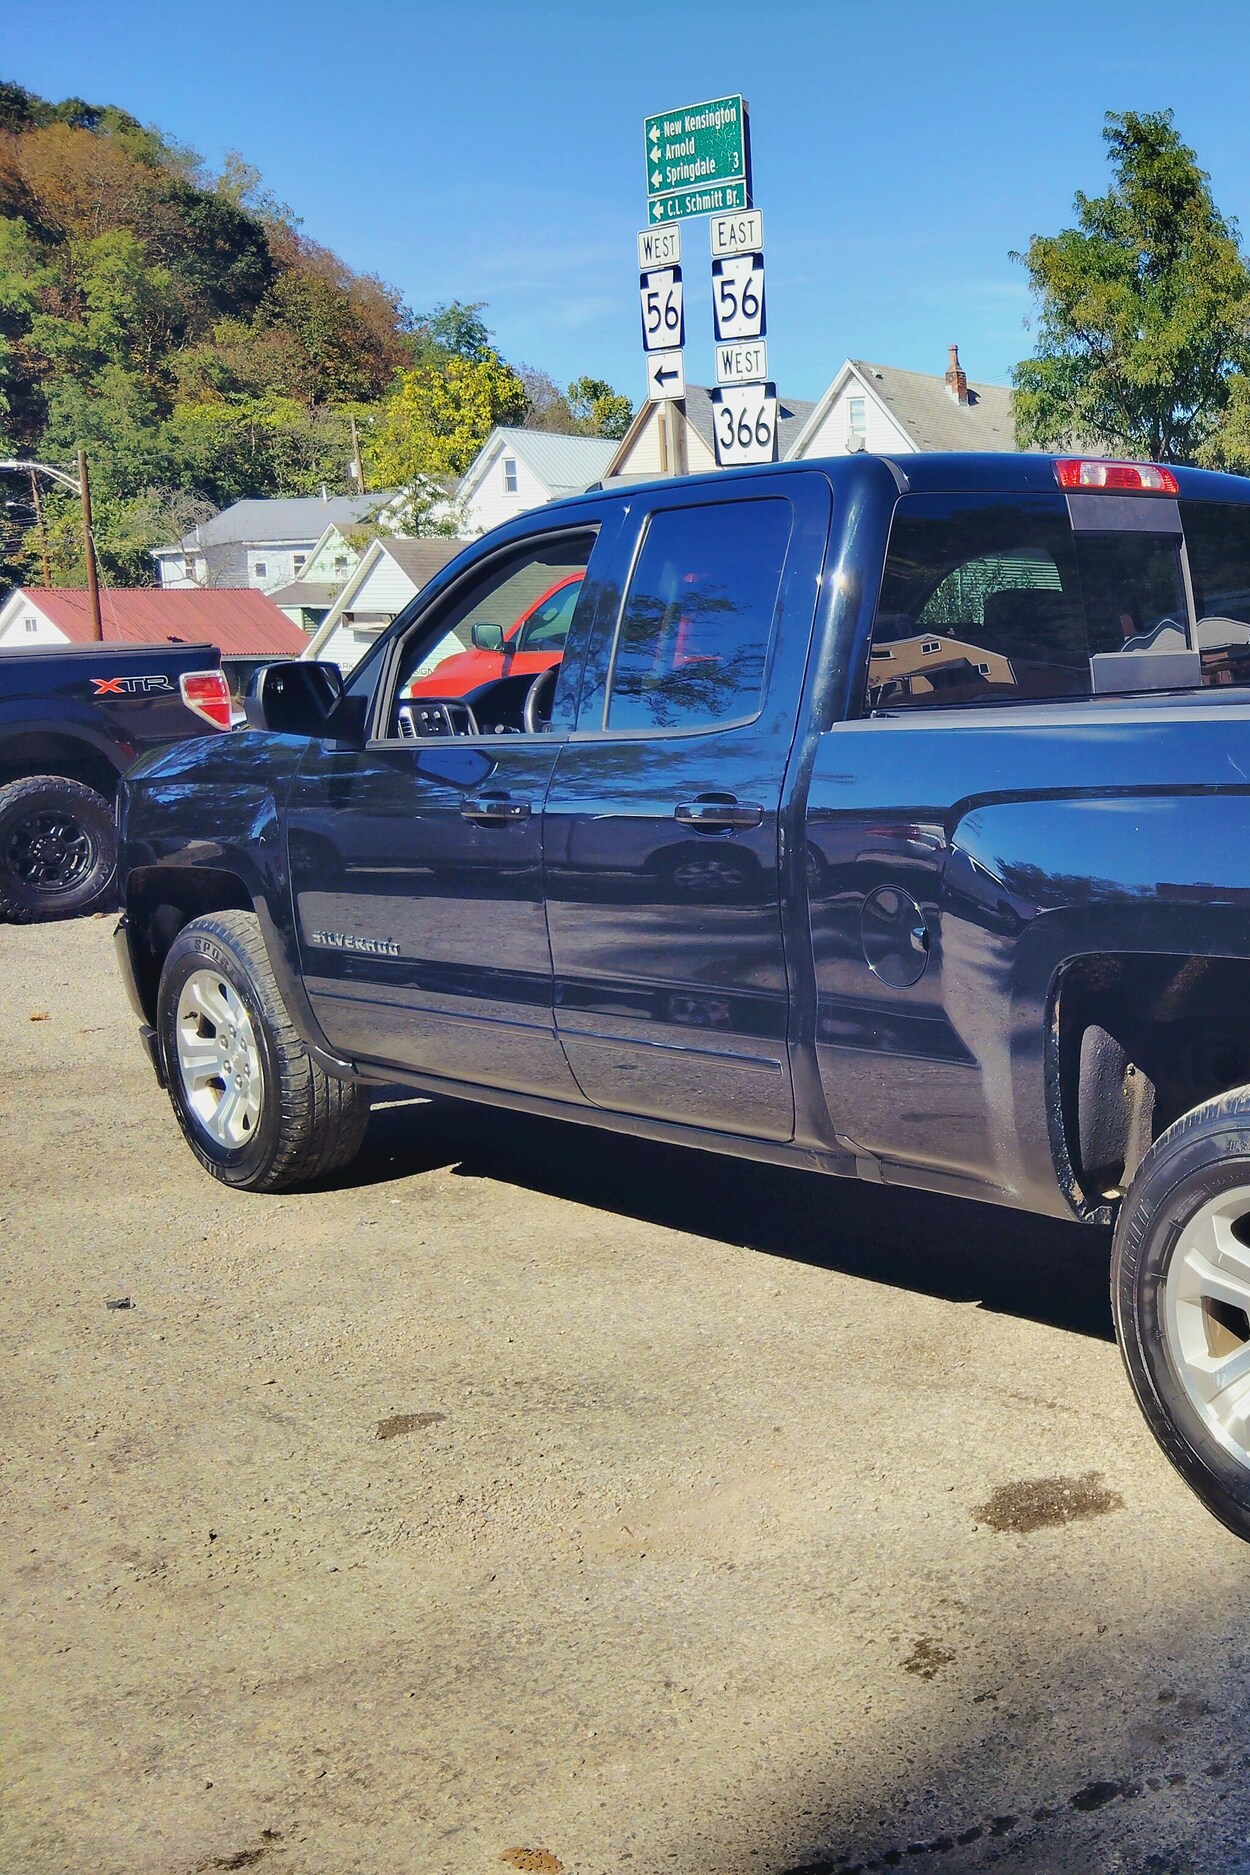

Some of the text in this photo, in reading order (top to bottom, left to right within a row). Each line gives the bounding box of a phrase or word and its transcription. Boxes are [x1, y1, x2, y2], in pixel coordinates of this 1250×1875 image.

[664, 107, 737, 138] New Kensington
[665, 137, 695, 160] Arnold
[666, 152, 739, 185] Springdale 3
[667, 189, 740, 217] C.L. Schmitt Br.
[718, 220, 755, 246] EAST
[643, 234, 675, 261] WEST
[648, 289, 679, 333] 56
[720, 277, 760, 323] 56
[722, 350, 760, 375] WEST
[720, 405, 771, 450] 366
[89, 675, 175, 695] XTR
[312, 930, 400, 956] SILVERADO
